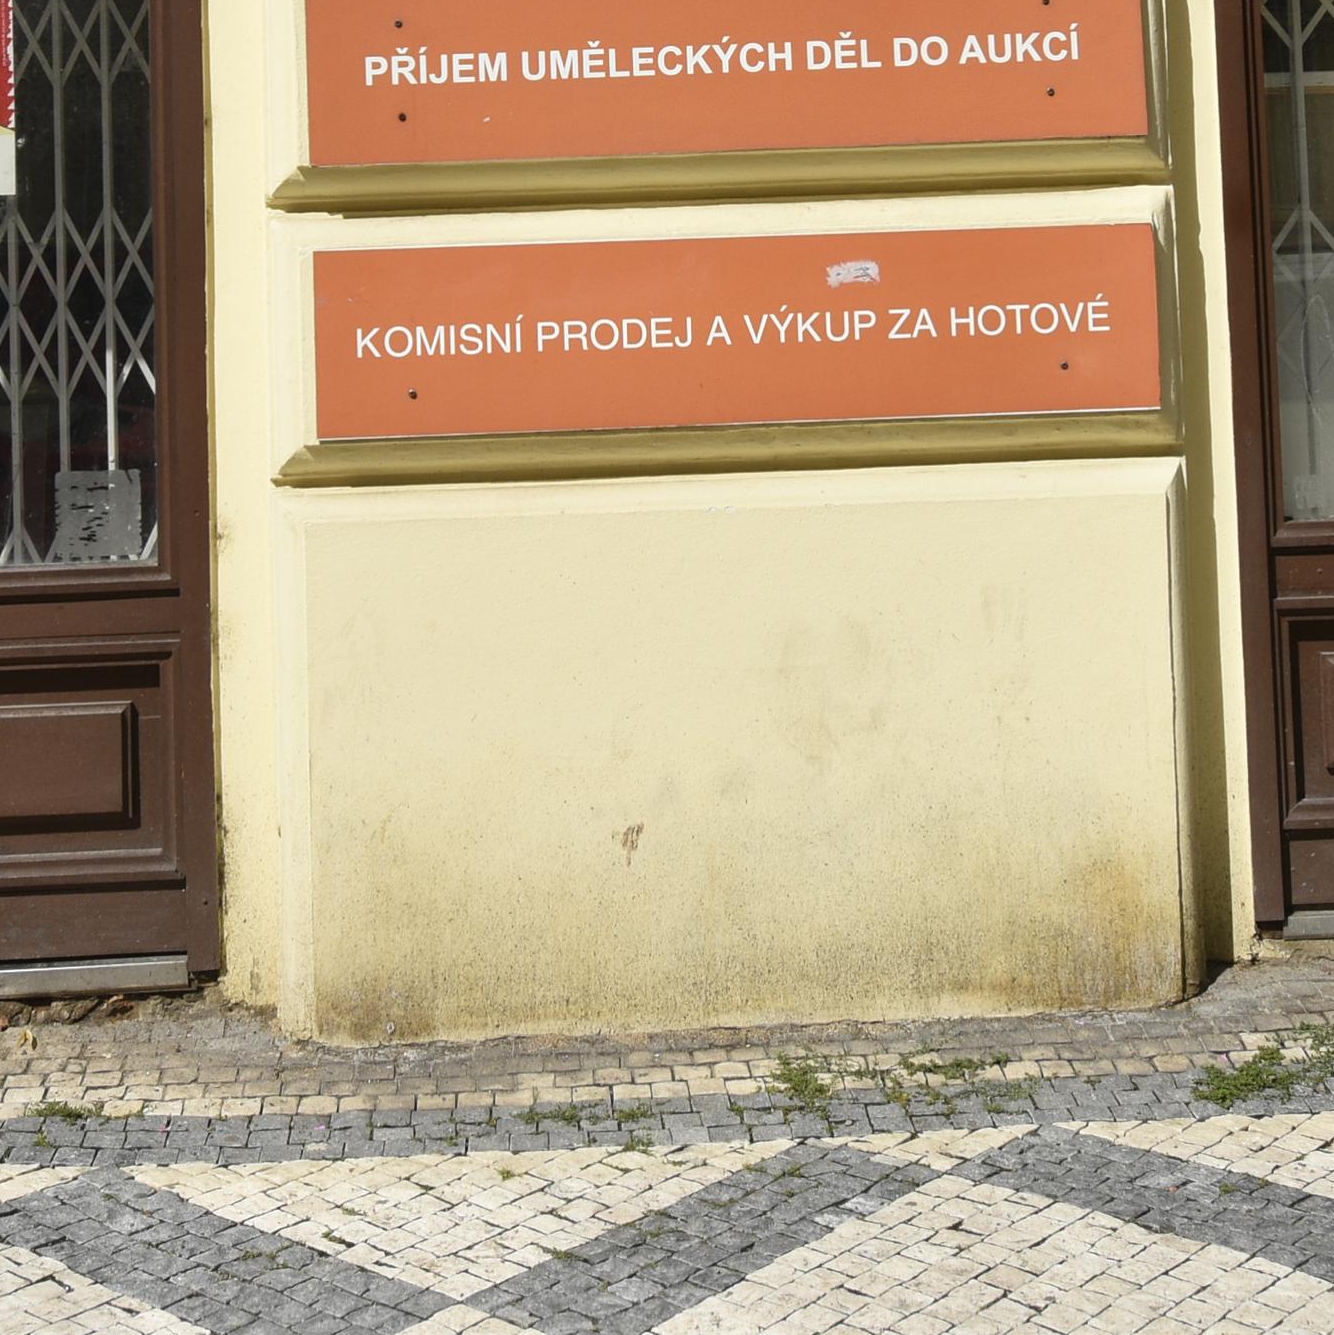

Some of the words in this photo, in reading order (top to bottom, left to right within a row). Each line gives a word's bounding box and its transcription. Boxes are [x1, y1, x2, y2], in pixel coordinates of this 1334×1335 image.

[365, 46, 508, 86] PŘÍJEM
[521, 31, 793, 81] UMĚLECKÝCH
[806, 31, 882, 70] DĚL
[893, 35, 949, 67] DO
[959, 22, 1080, 65] AUKCÍ
[356, 314, 524, 358] KOMISNÍ
[537, 316, 693, 352] PRODEJ
[706, 315, 732, 346] A
[743, 304, 877, 344] VÝKUP
[888, 308, 937, 339] ZA
[950, 293, 1111, 337] HOTOVÉ
